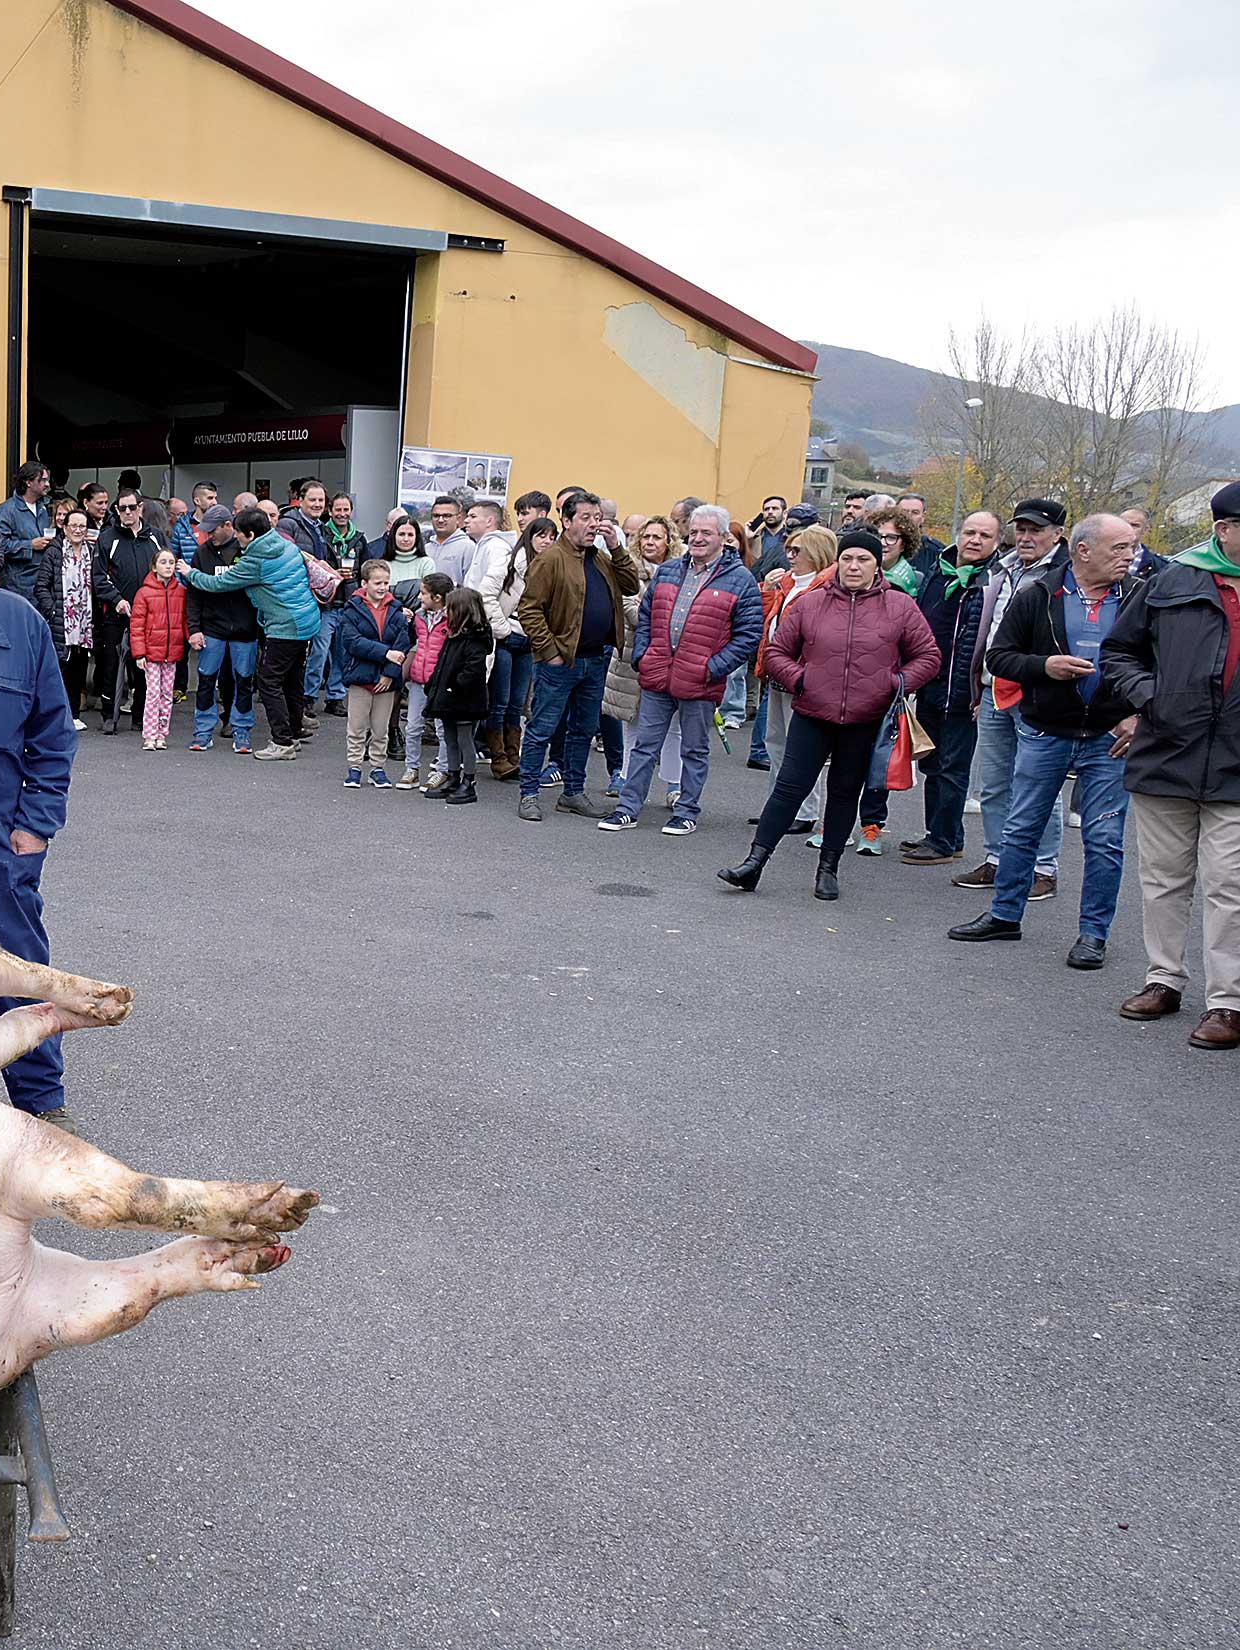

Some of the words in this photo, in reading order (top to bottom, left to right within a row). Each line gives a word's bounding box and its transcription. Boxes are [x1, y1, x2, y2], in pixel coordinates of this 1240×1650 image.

[194, 432, 246, 445] AYUNTAMIENTO
[247, 430, 274, 442] PUEBLA
[276, 430, 286, 441] DE
[288, 428, 309, 441] LILLO
